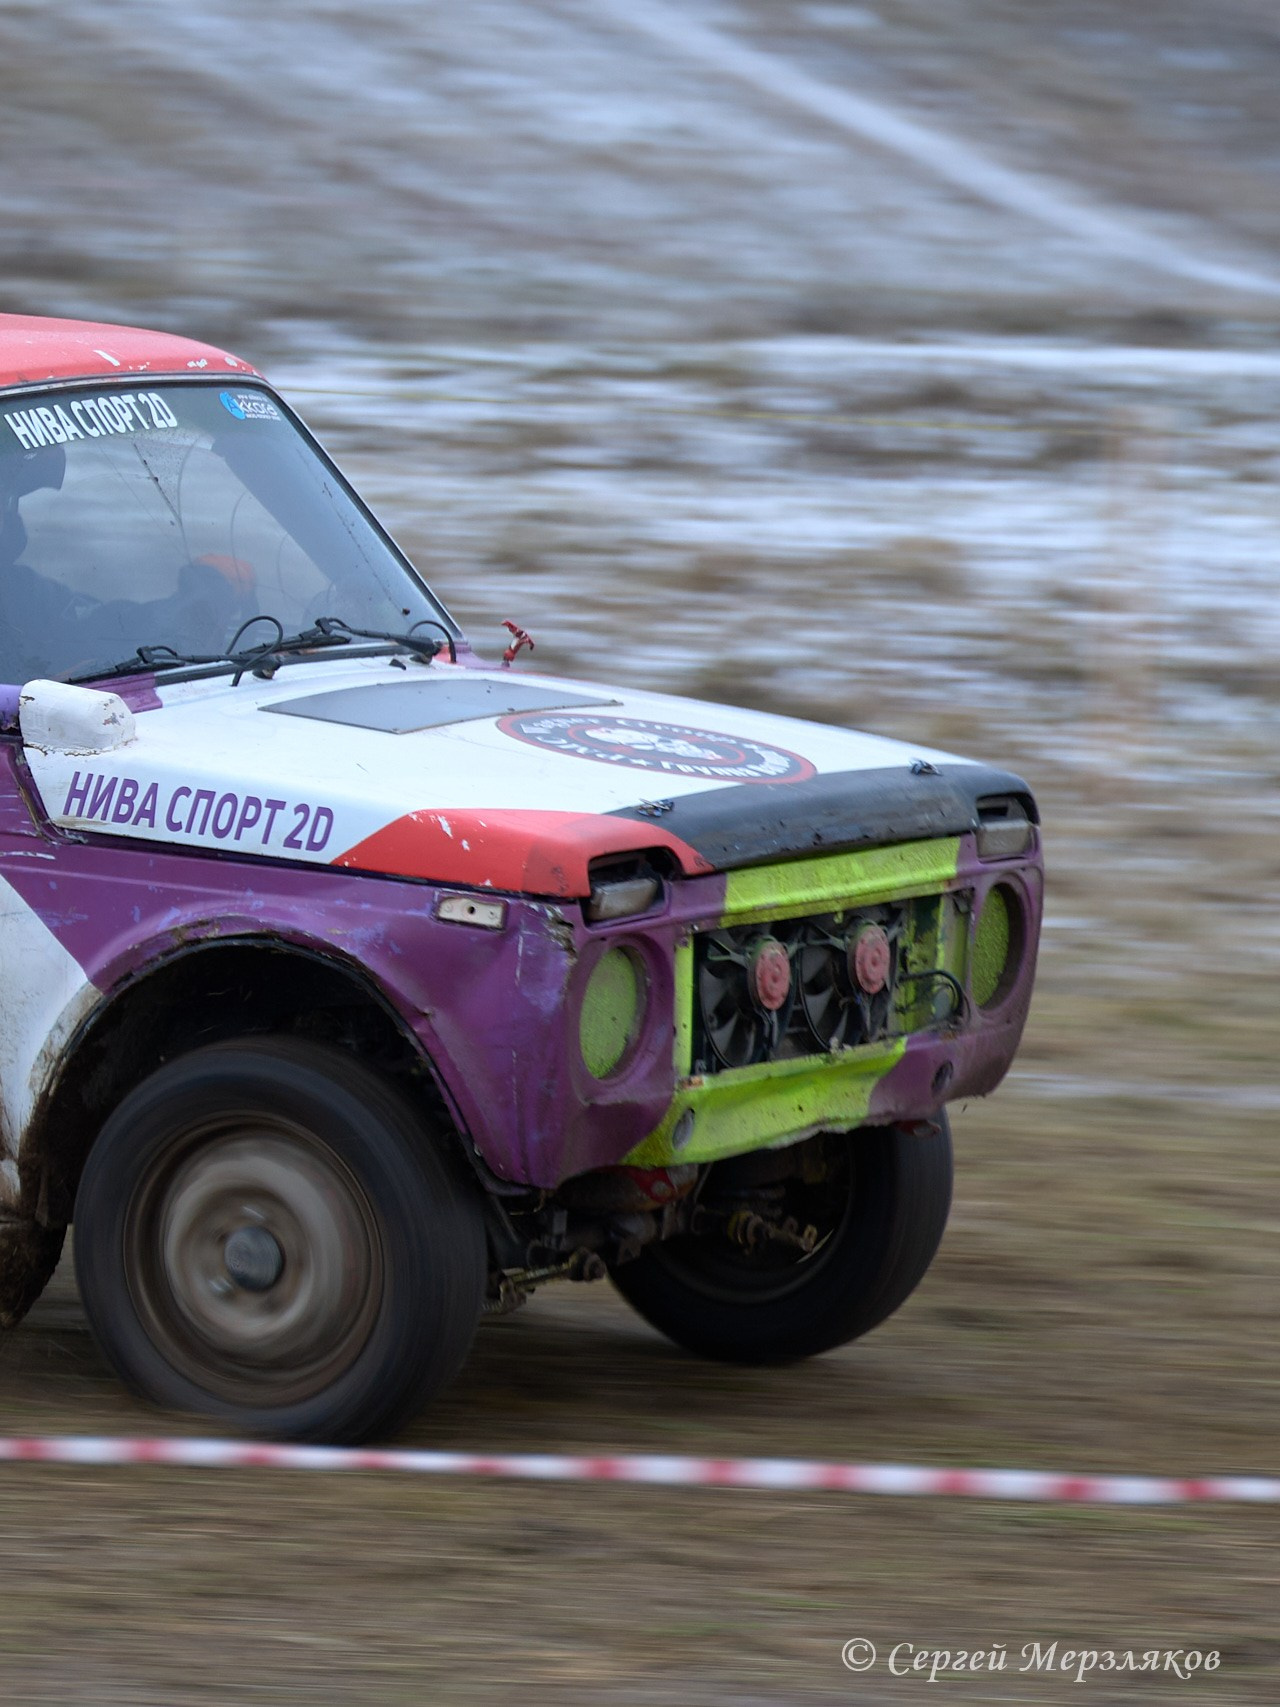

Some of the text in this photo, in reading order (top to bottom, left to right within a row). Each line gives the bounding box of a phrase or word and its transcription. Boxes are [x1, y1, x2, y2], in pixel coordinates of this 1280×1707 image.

[3, 392, 178, 450] НИВА СПОРТ 2D
[62, 771, 335, 852] НИВА СПОРТ 2D
